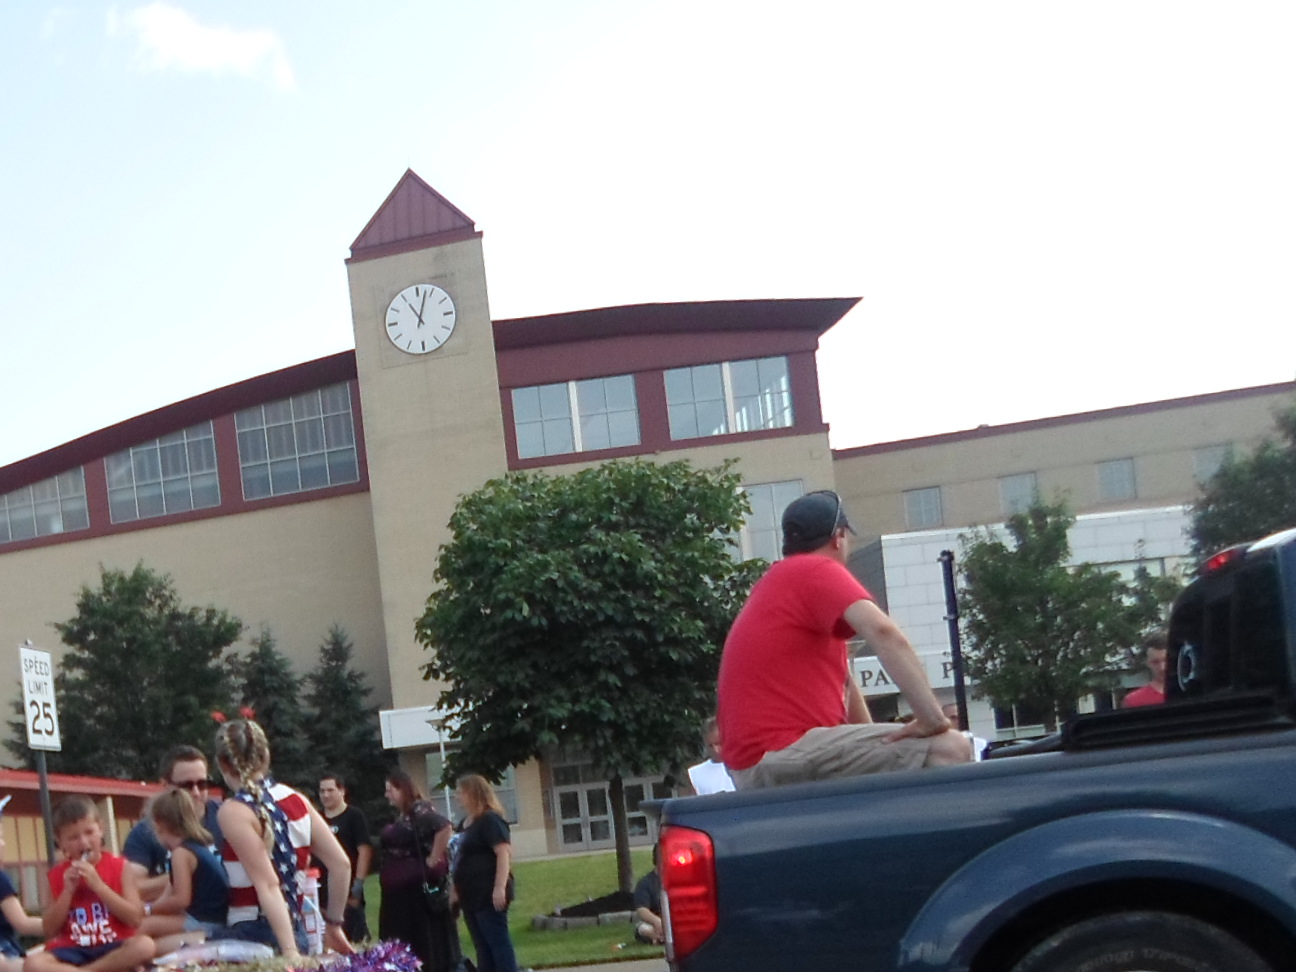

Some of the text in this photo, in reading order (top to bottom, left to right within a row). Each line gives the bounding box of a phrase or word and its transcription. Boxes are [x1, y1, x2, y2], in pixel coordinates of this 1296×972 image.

[24, 658, 50, 677] SPEED
[861, 668, 895, 688] PA
[27, 681, 48, 696] LIMIT
[29, 700, 55, 736] 25
